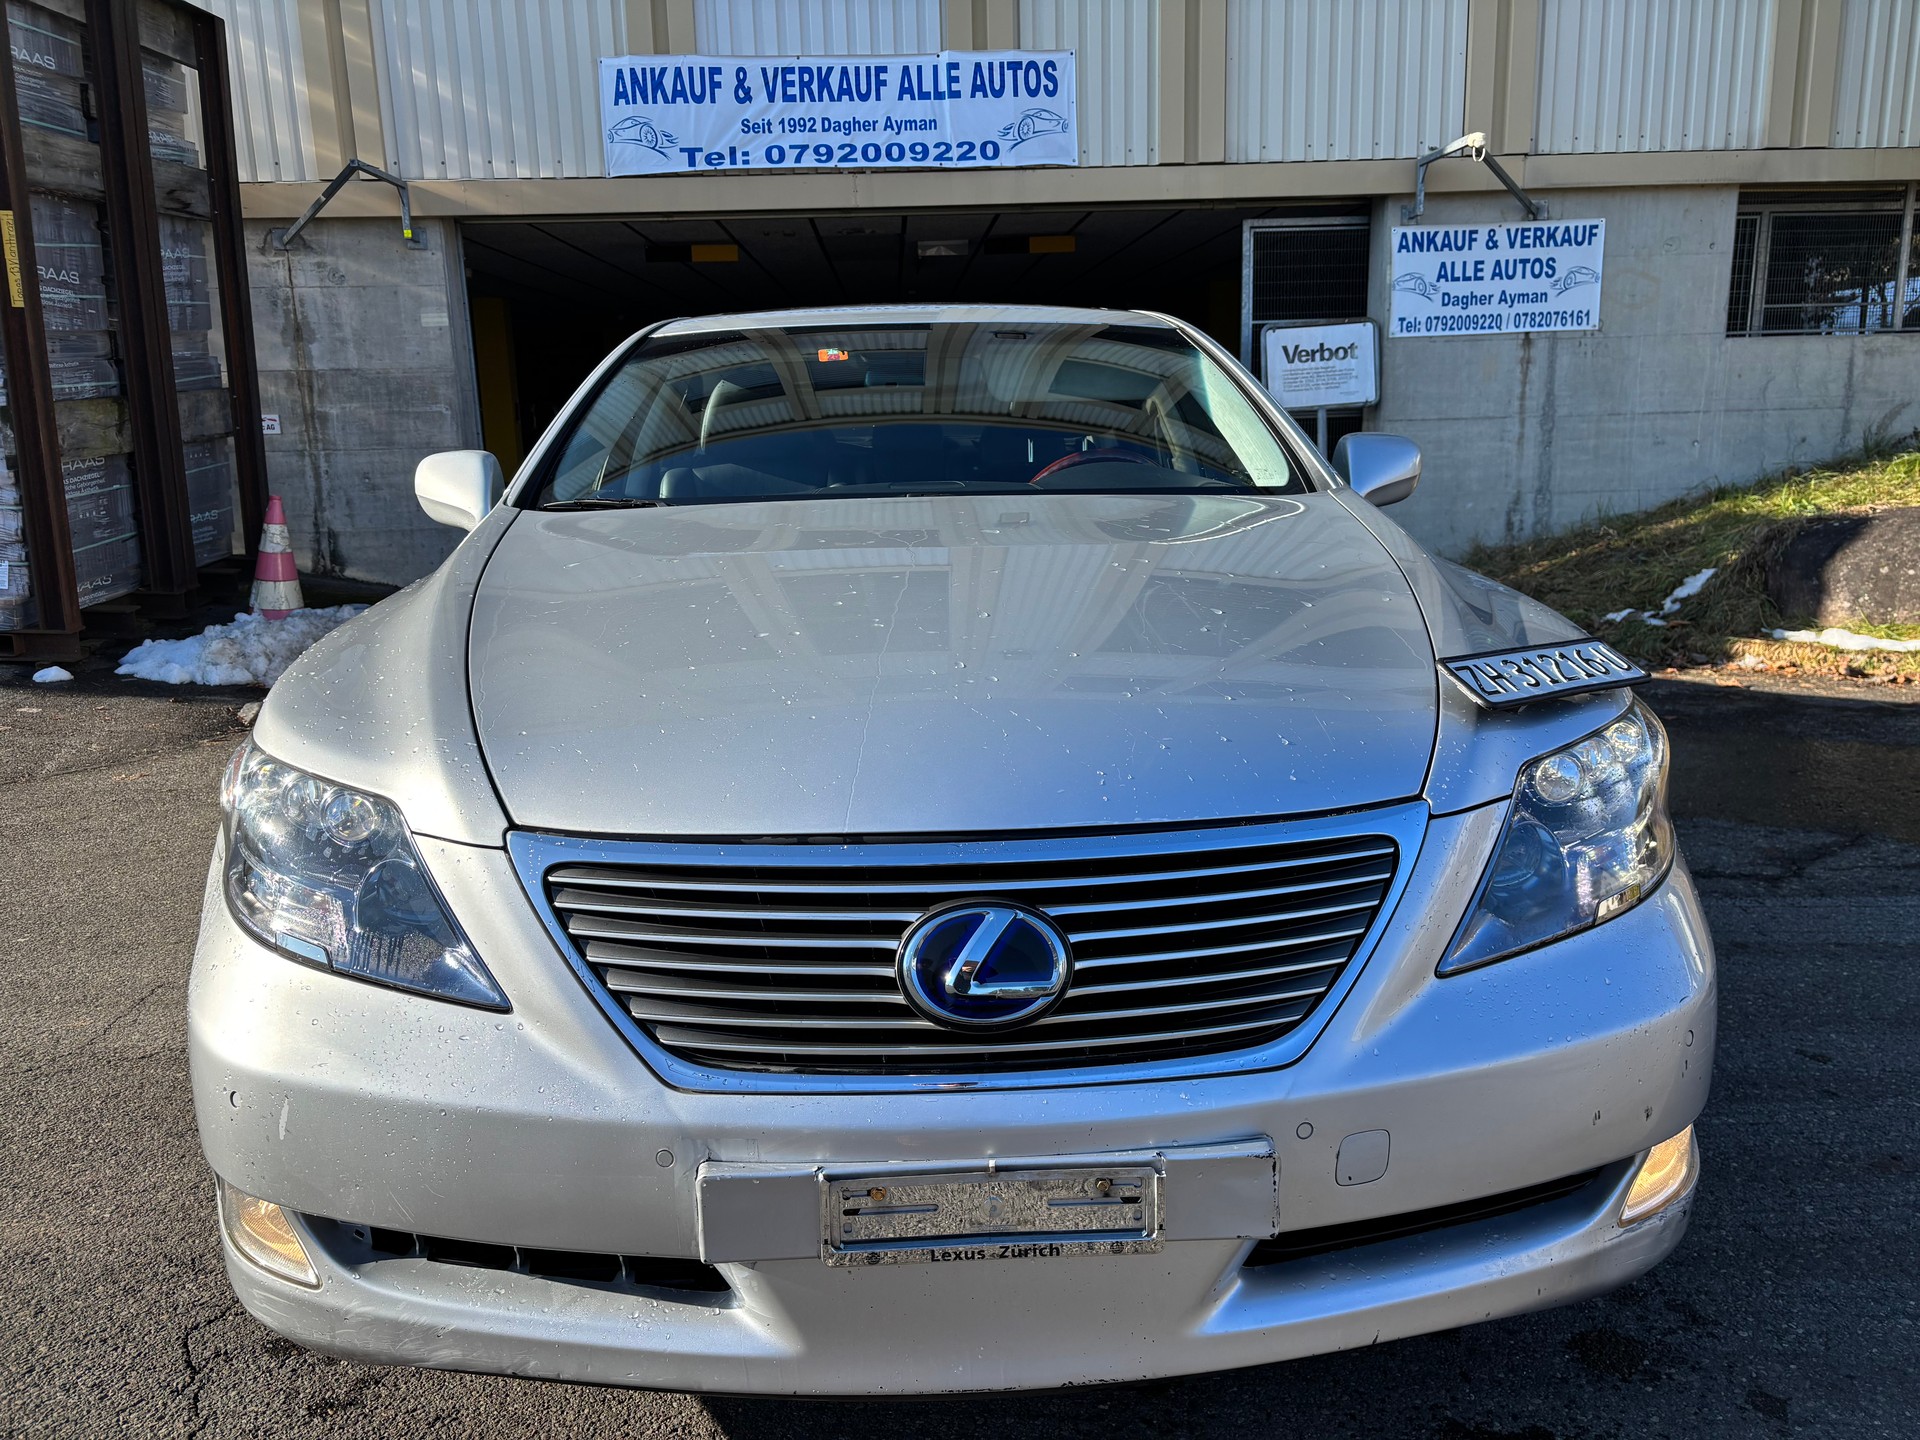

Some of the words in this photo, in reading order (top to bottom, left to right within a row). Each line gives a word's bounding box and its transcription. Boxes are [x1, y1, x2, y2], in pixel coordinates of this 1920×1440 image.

[614, 66, 722, 106] ANKAUF
[734, 66, 753, 104] &
[760, 65, 888, 103] VERKAUF
[897, 62, 961, 101] ALLE
[970, 60, 1058, 98] AUTOS
[741, 118, 773, 134] Seit
[778, 117, 817, 133] 1992
[821, 116, 878, 136] Dagher
[883, 116, 937, 135] Ayman
[679, 146, 751, 168] Tel:
[765, 139, 1000, 165] 0792009220
[1397, 229, 1479, 253] ANKAUF
[1485, 228, 1499, 250] &
[1506, 224, 1599, 249] VERKAUF
[1436, 260, 1485, 283] ALLE
[1490, 257, 1556, 281] AUTOS
[1441, 291, 1494, 310] Dagher
[1498, 289, 1548, 308] Ayman
[1398, 317, 1421, 333] Tel:
[1514, 309, 1590, 329] 0782076161
[1282, 342, 1359, 364] Verbot
[930, 1249, 986, 1262] Lexus
[998, 1243, 1060, 1259] Zürich
